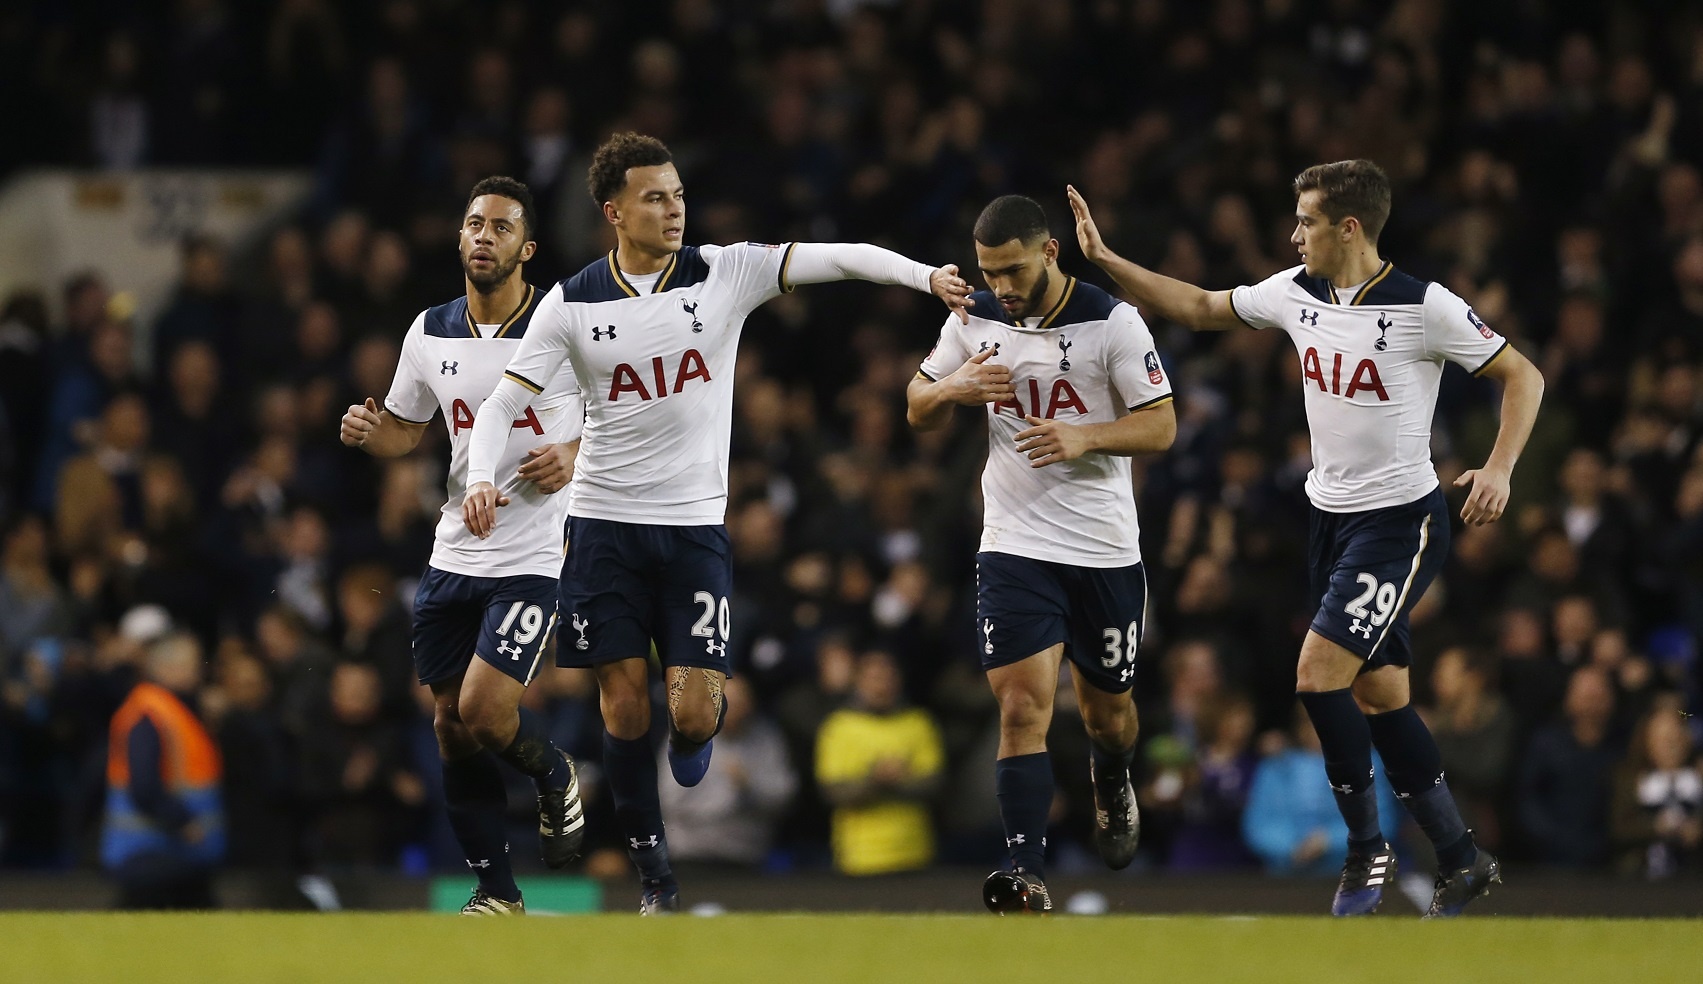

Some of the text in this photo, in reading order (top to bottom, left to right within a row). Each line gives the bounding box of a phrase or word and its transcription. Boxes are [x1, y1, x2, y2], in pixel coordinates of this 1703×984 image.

[609, 349, 712, 401] AIA
[1303, 346, 1390, 401] AIA
[452, 398, 545, 436] AA
[496, 600, 543, 645] 19
[691, 591, 731, 642] 20
[1344, 572, 1396, 626] 29
[1101, 620, 1137, 668] 38
